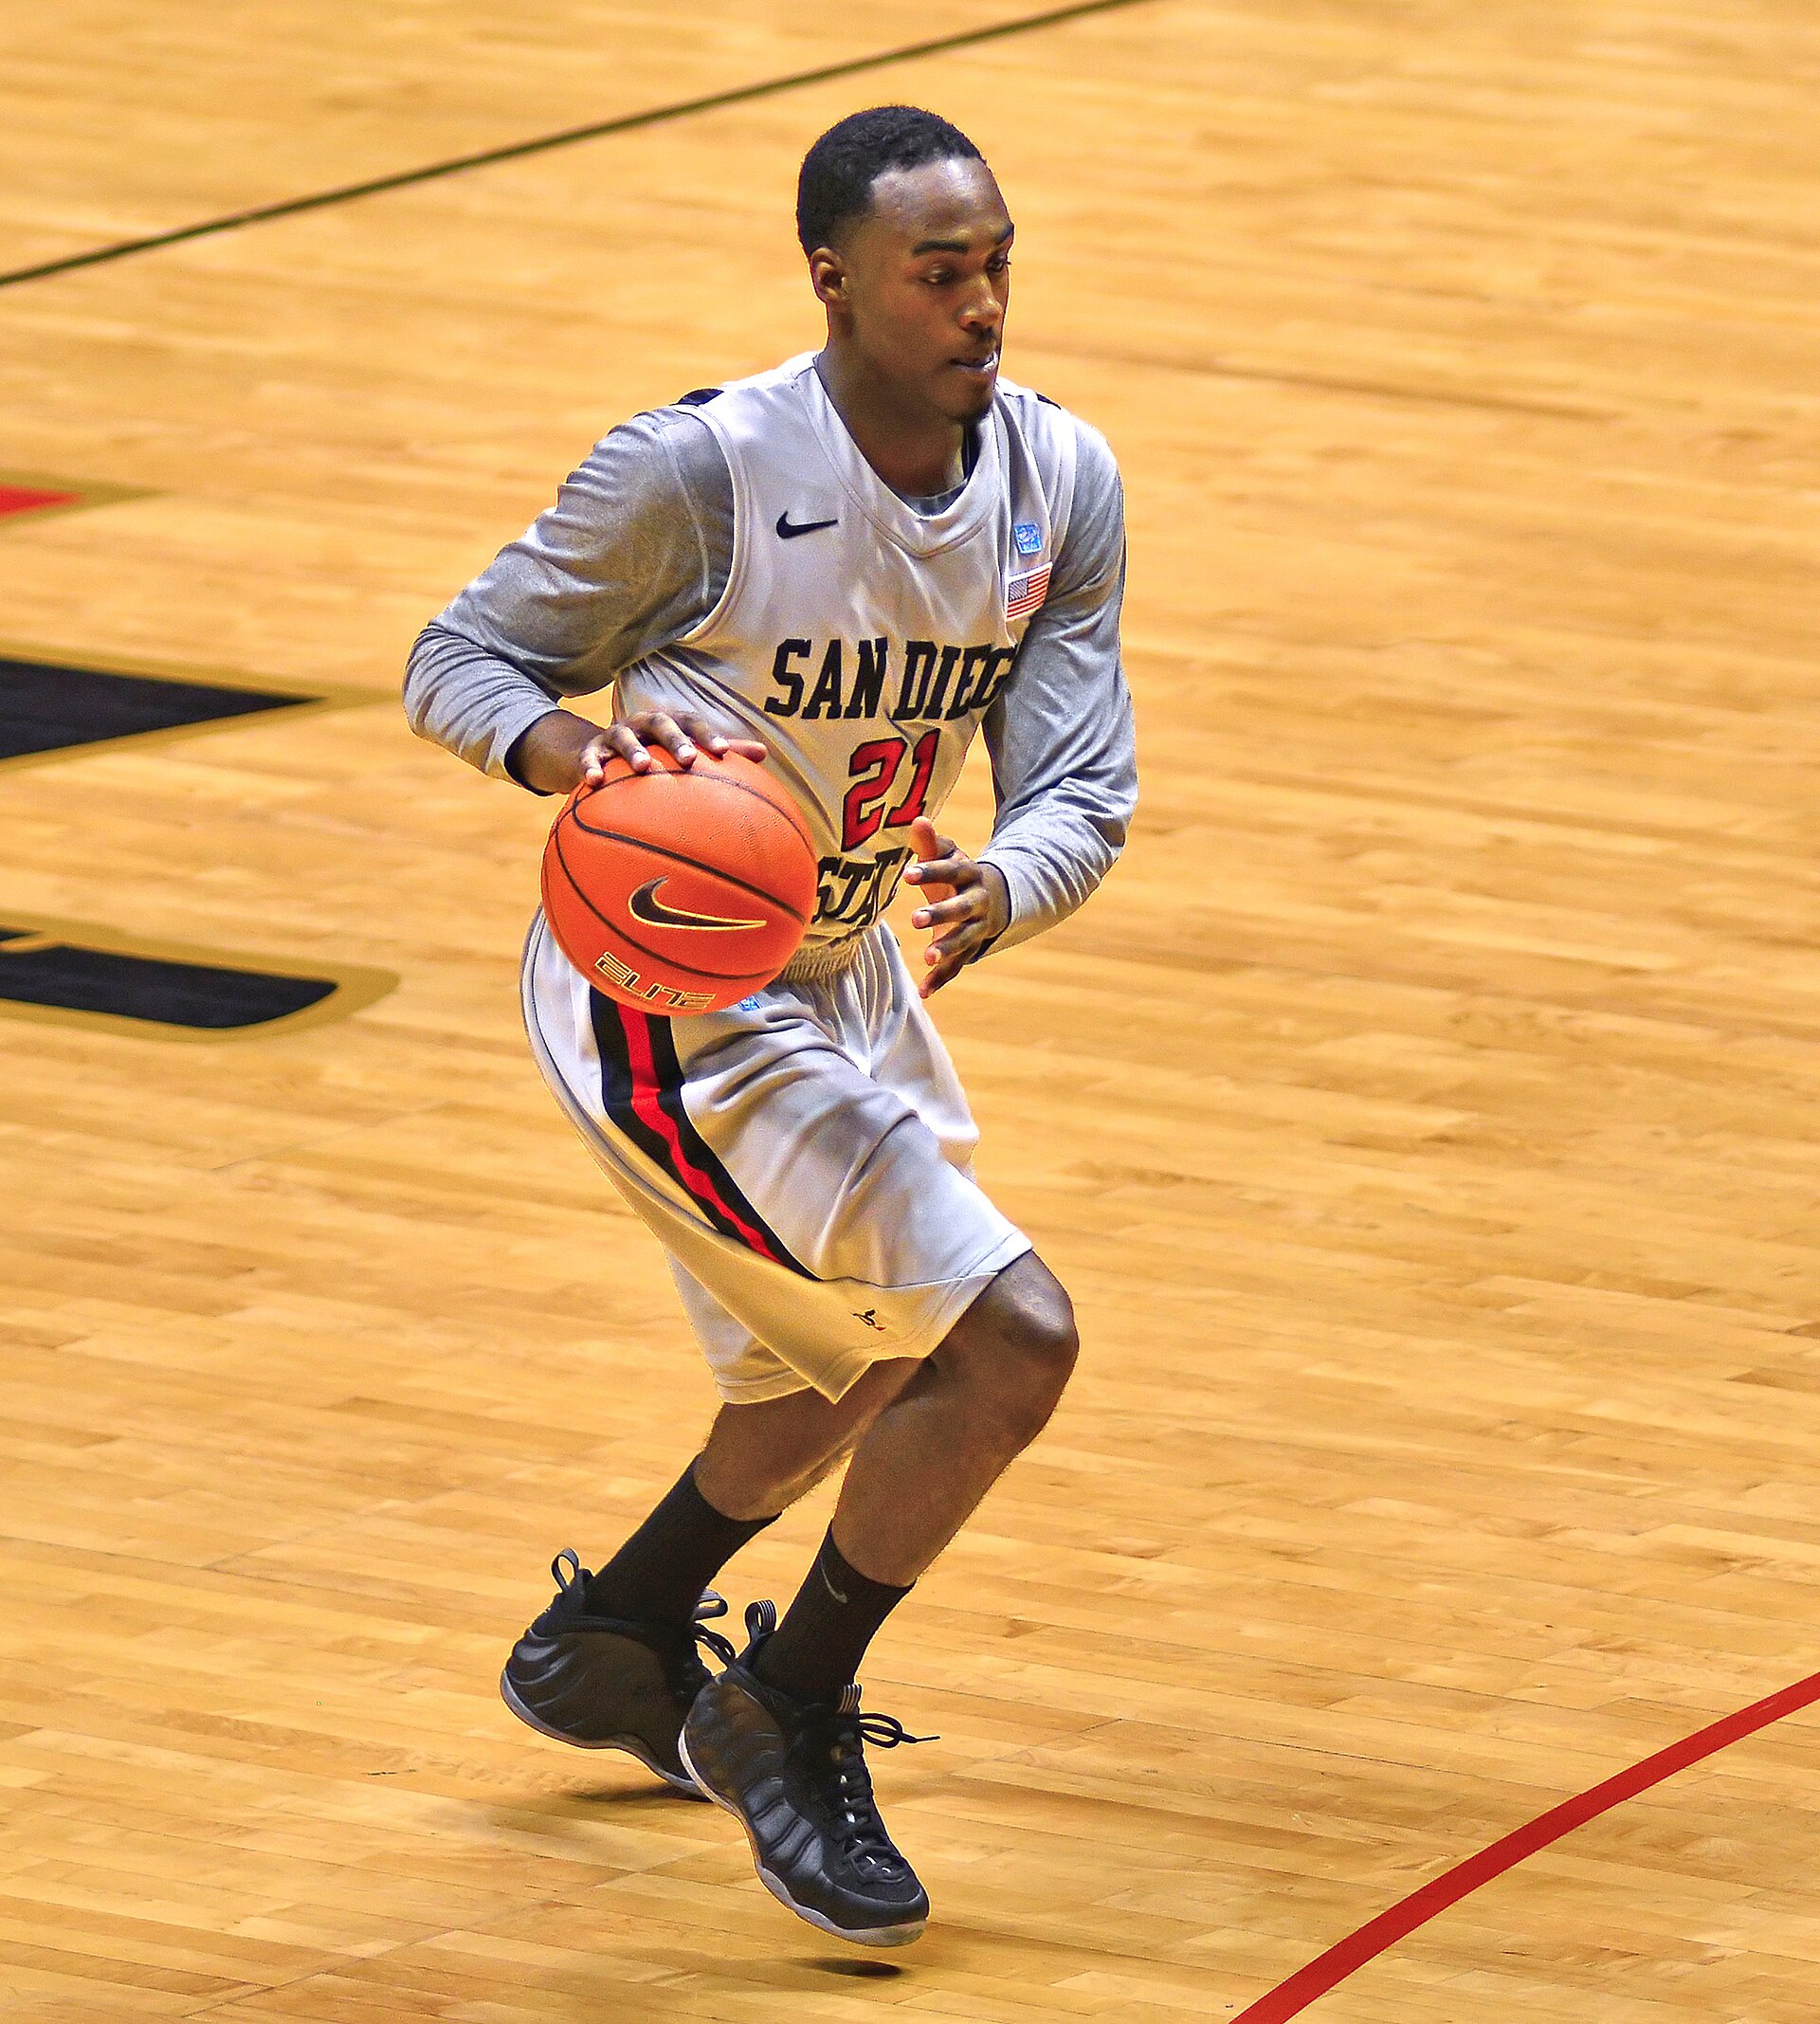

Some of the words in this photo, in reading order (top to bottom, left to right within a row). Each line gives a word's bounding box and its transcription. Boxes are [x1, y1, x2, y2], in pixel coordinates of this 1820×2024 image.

[765, 637, 888, 720] SAN
[893, 642, 1020, 720] DIEG
[841, 728, 940, 851] 21
[811, 847, 914, 926] STAT
[594, 951, 716, 1010] ELITE
